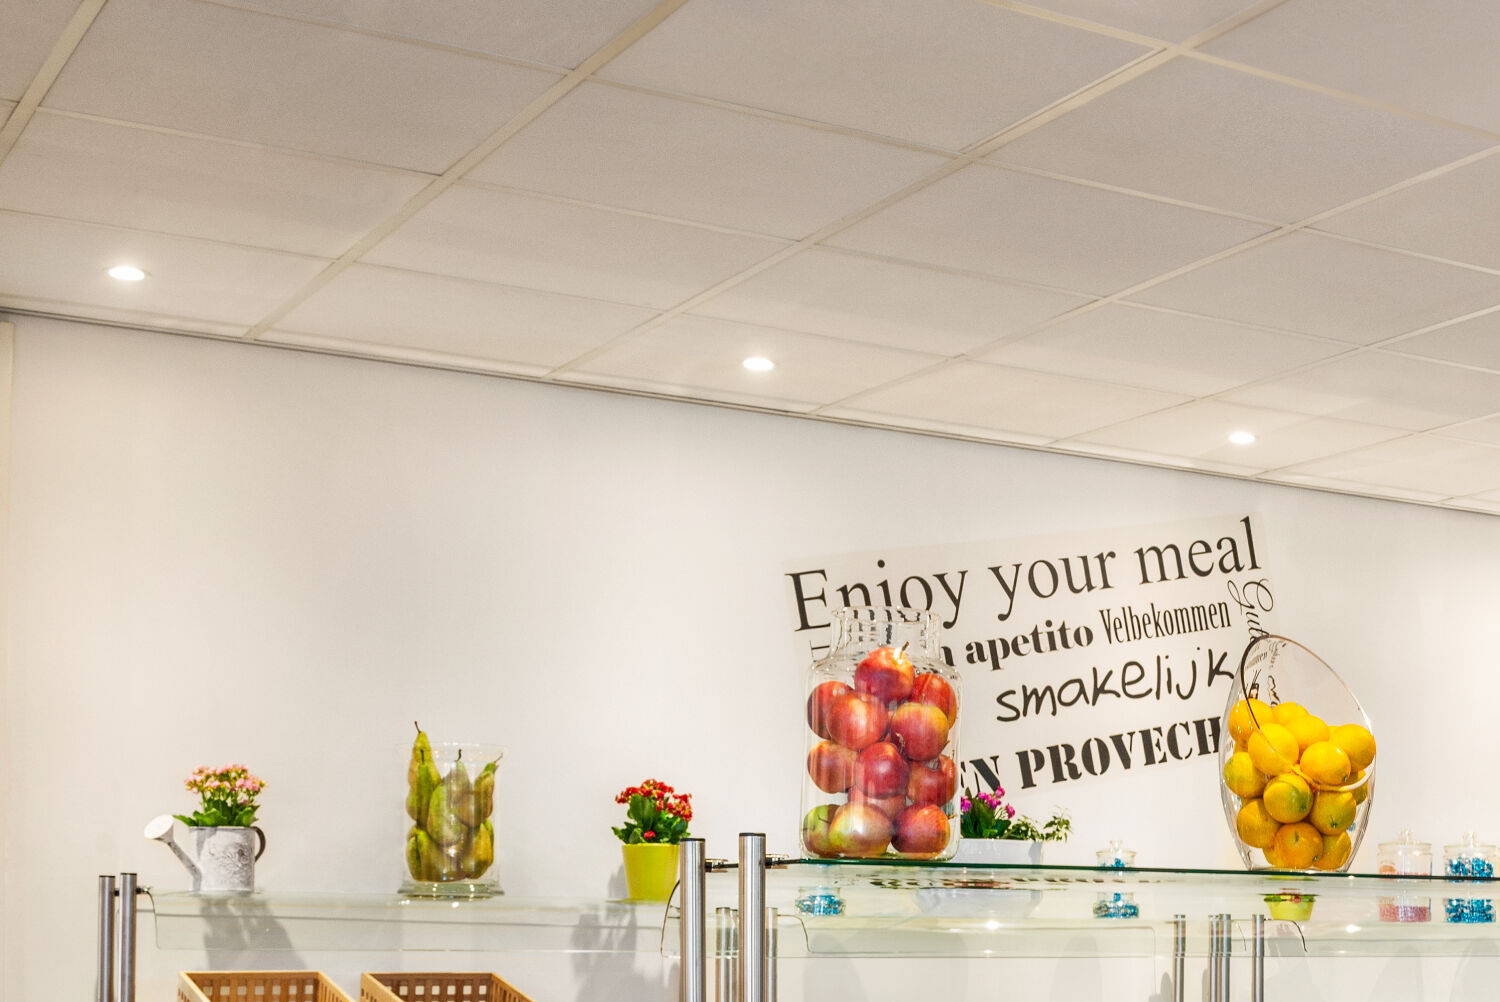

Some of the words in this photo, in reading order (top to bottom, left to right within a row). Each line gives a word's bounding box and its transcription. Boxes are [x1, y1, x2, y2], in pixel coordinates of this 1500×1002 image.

[784, 558, 968, 632] Enjoy
[987, 551, 1117, 621] your
[1133, 515, 1263, 585] meal
[964, 619, 1095, 671] apetito
[1098, 601, 1233, 645] Velbekommen
[995, 646, 1235, 722] smakelijk
[1015, 715, 1222, 790] PROVECH
